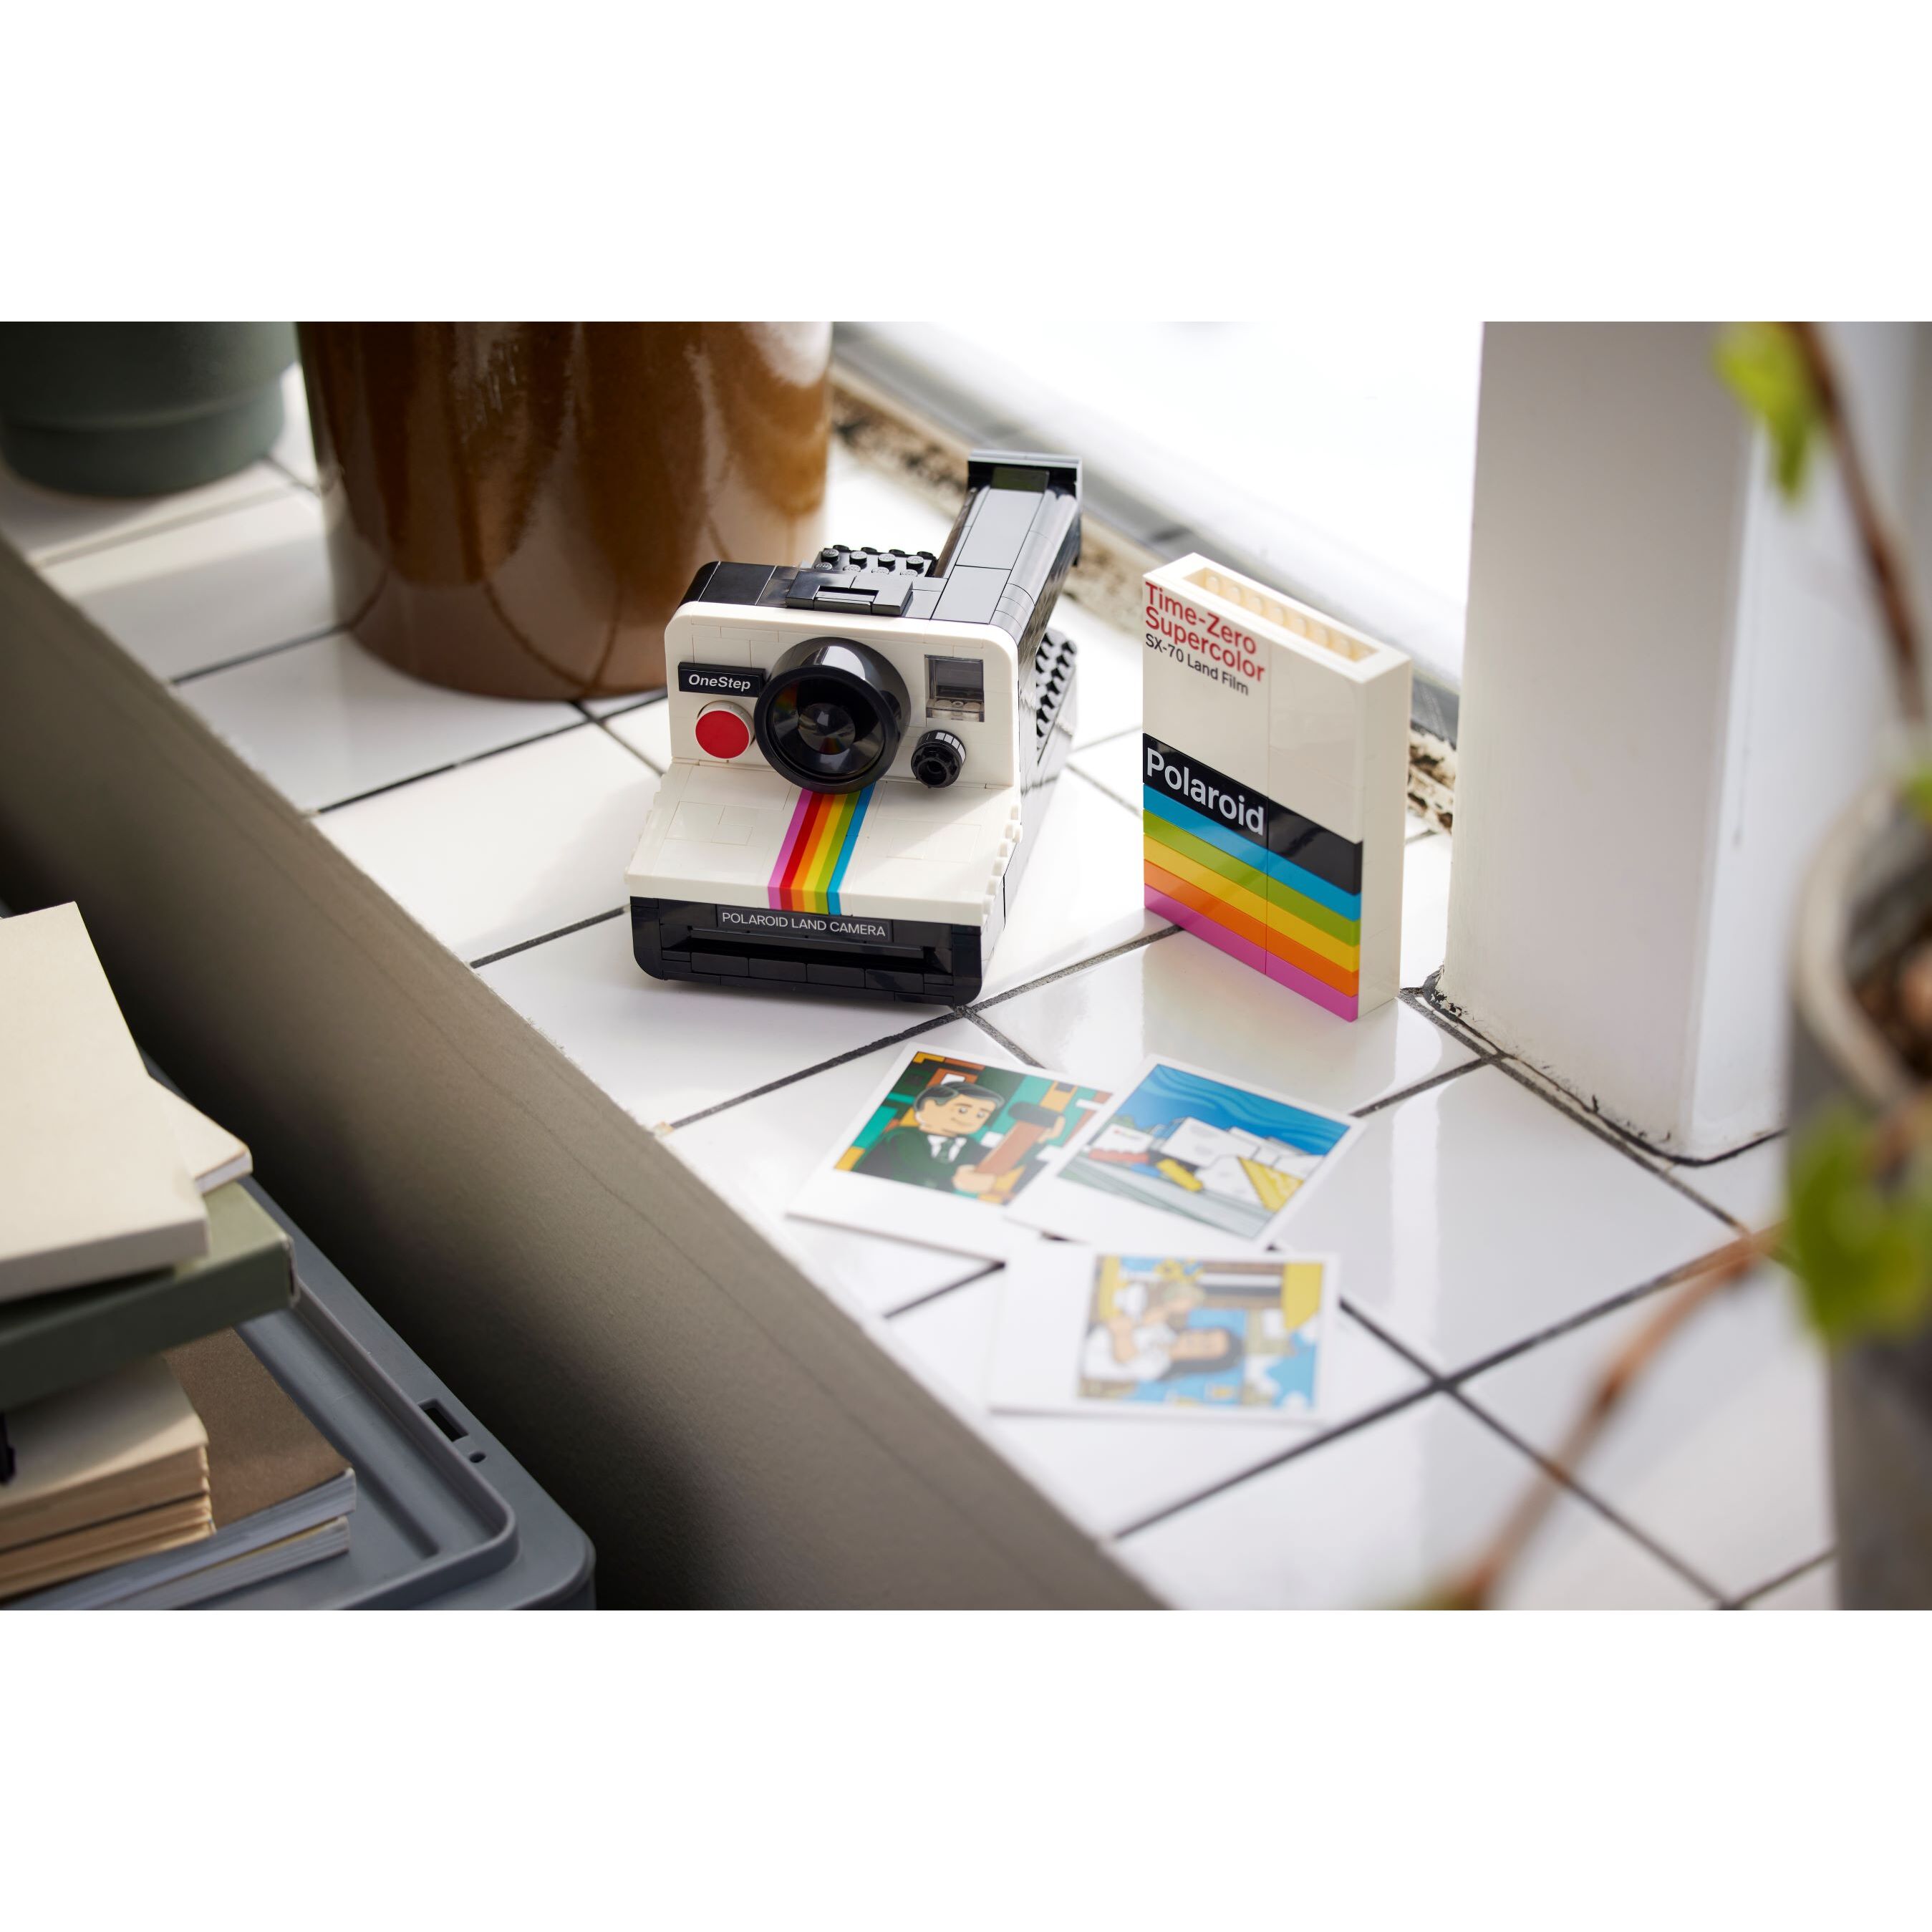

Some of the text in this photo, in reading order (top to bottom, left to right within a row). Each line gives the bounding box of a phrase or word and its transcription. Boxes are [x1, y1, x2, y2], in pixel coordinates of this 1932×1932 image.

[1145, 581, 1257, 655] Time-Zero
[1146, 606, 1265, 682] Supercolor
[688, 674, 751, 692] OneStep
[1146, 633, 1248, 695] SX-70 Land Film
[1146, 747, 1264, 836] Polaroid
[723, 912, 886, 937] POLAROID LAND CAMERA
